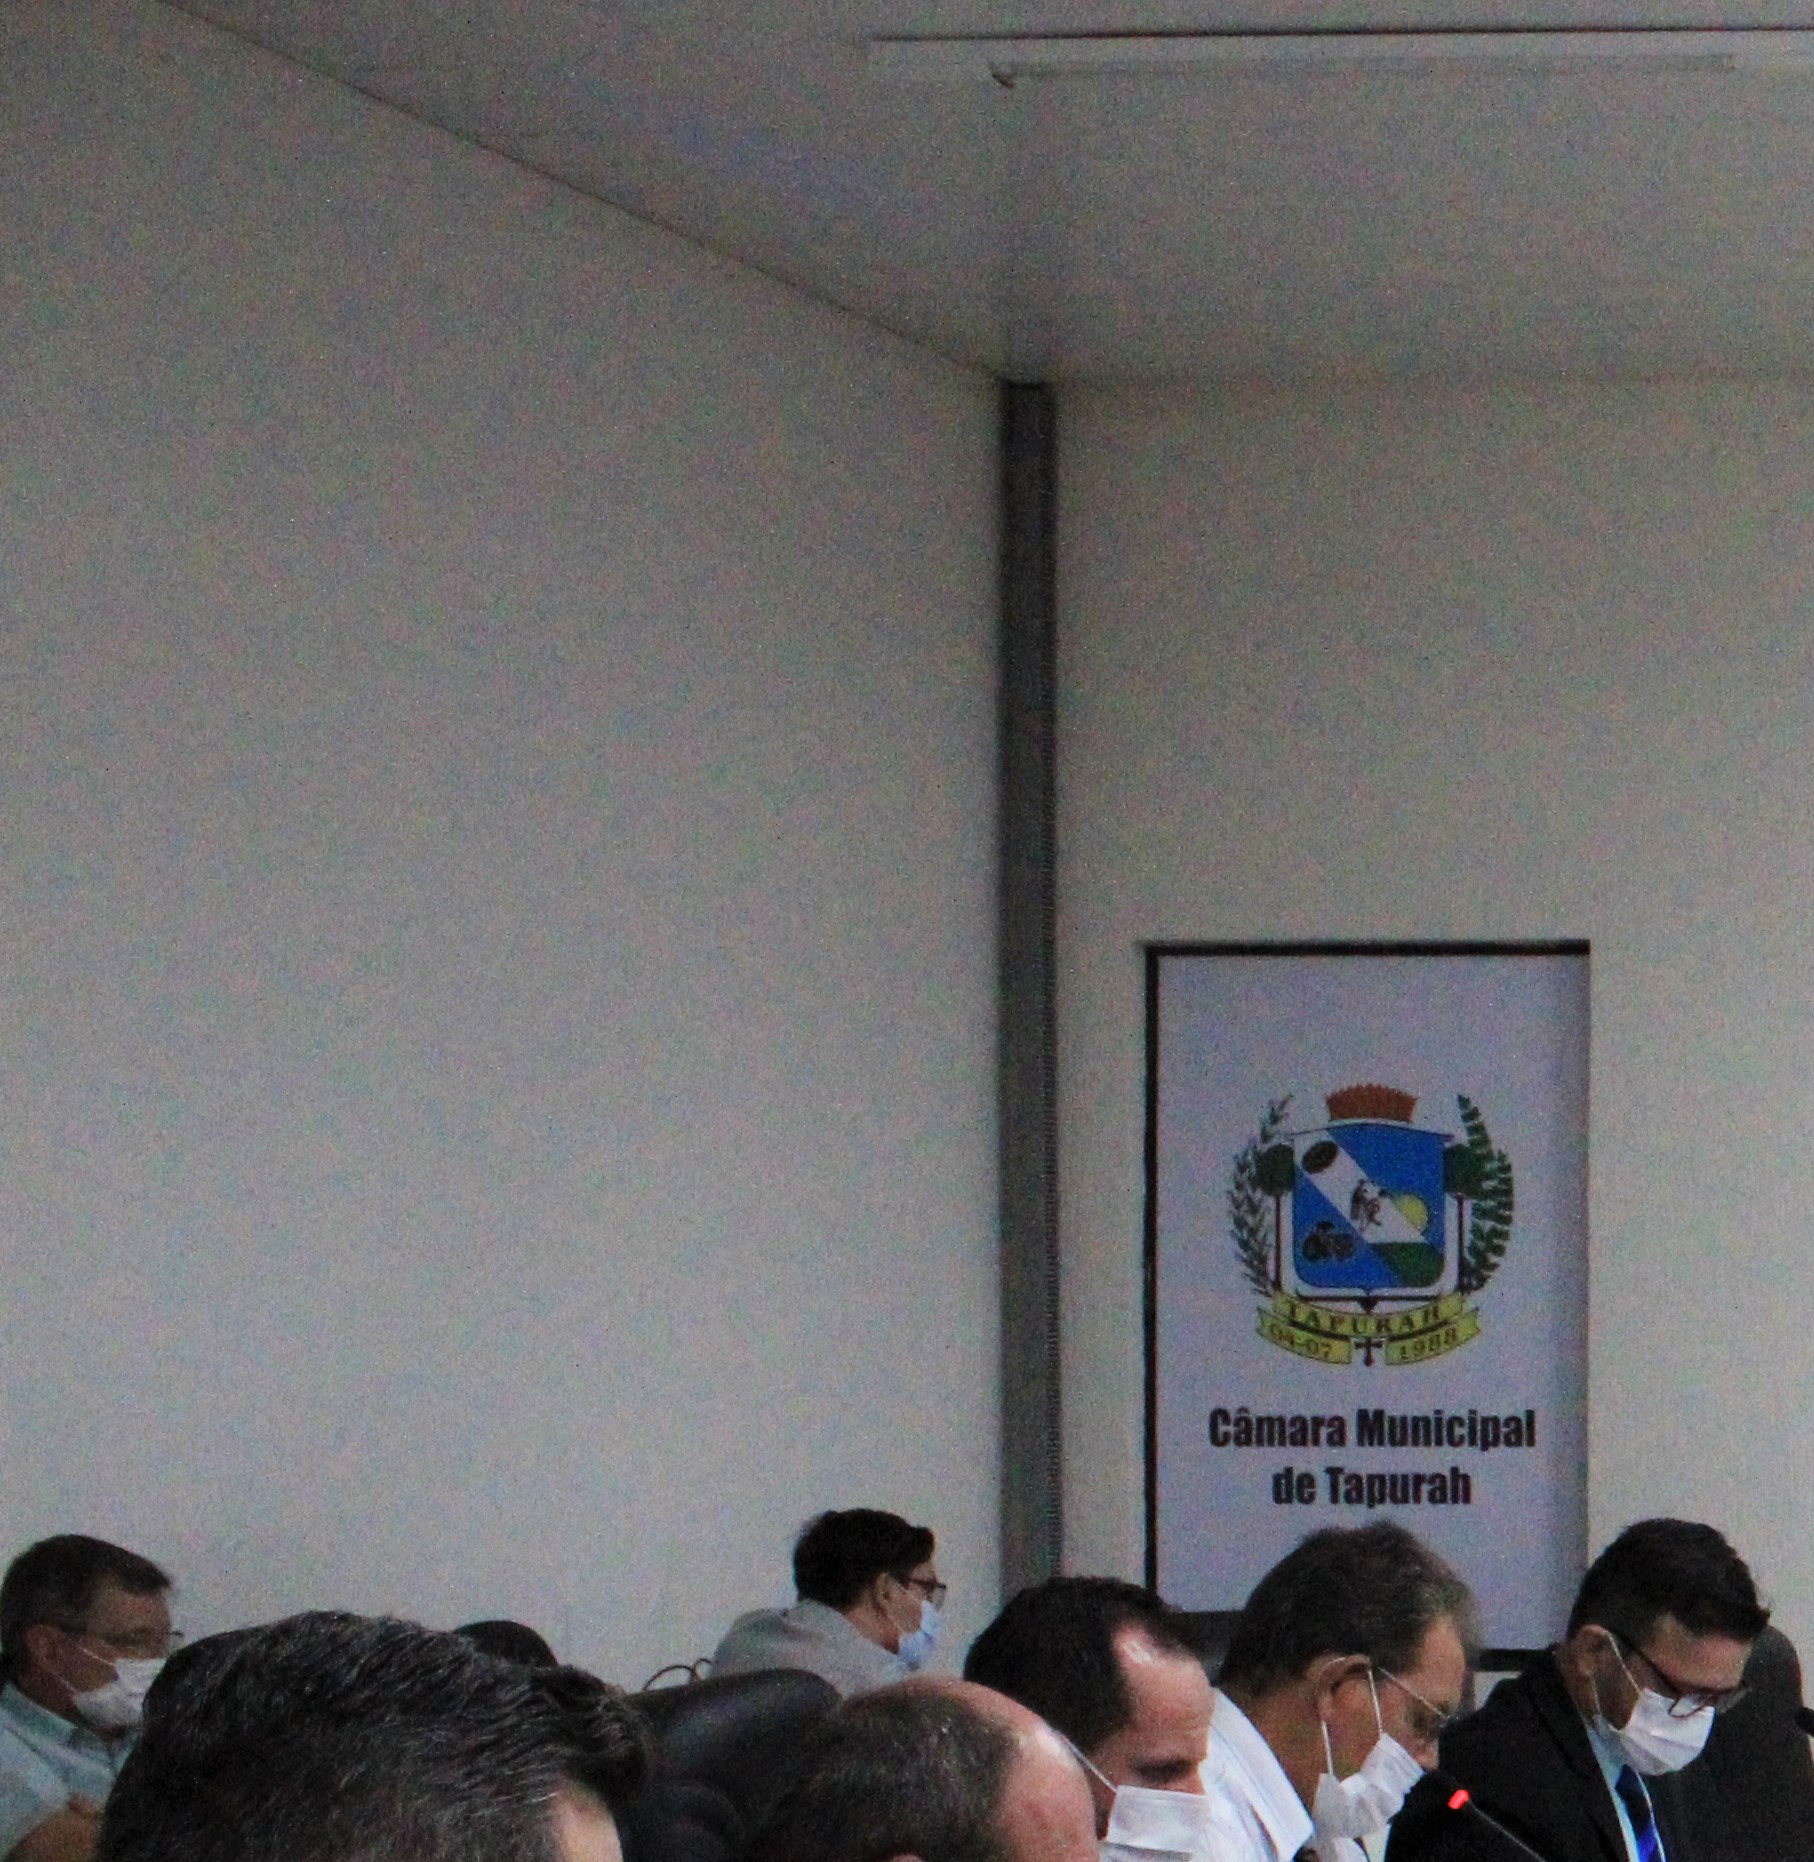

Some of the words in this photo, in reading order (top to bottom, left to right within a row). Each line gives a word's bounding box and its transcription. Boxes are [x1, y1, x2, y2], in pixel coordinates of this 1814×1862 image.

[1288, 1302, 1441, 1334] TAPURAH
[1208, 1406, 1348, 1448] Câmara
[1356, 1407, 1537, 1452] Municipal
[1271, 1466, 1317, 1505] de
[1325, 1466, 1473, 1509] Tapurah
